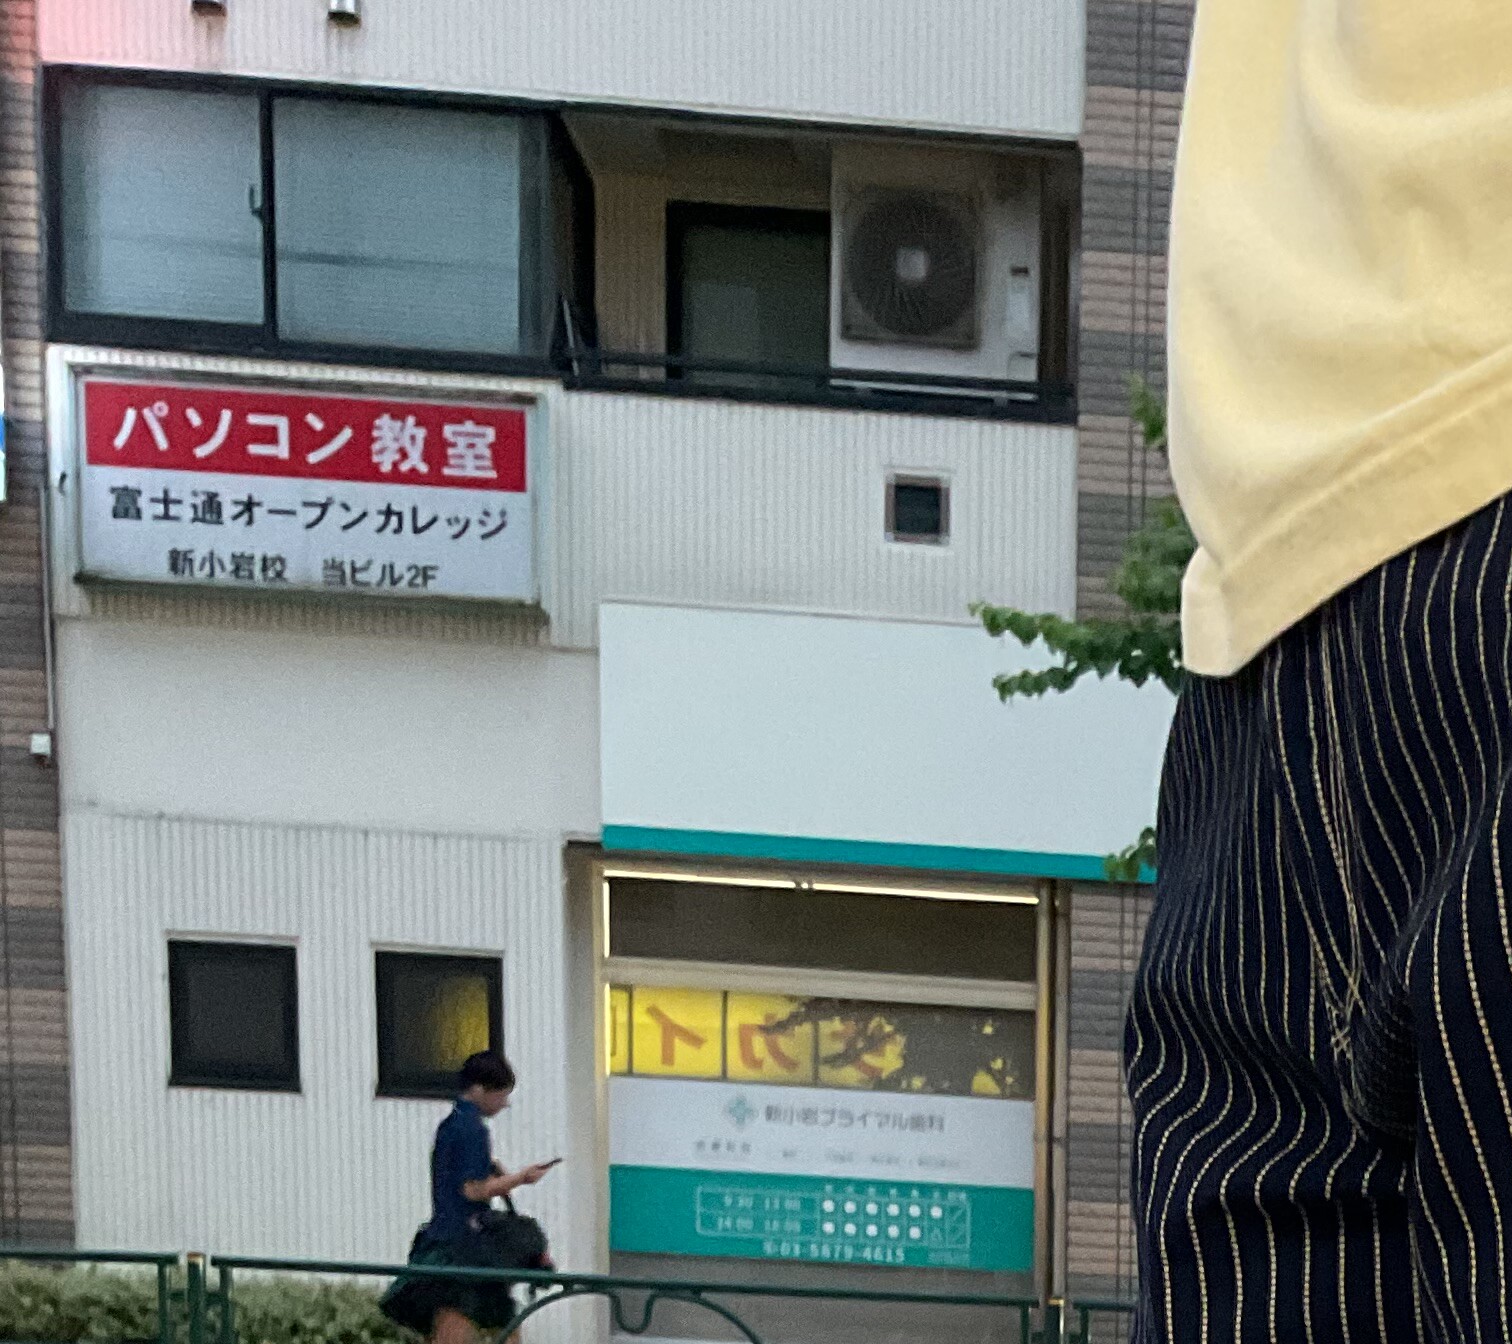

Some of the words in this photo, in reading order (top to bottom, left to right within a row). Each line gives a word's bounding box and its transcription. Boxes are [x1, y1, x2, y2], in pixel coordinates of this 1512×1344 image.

[113, 401, 499, 479] パソコン教室
[109, 485, 509, 541] 富士通オープンカレッジ
[167, 547, 289, 584] 新小岩校
[321, 557, 441, 590] 当ビル2F
